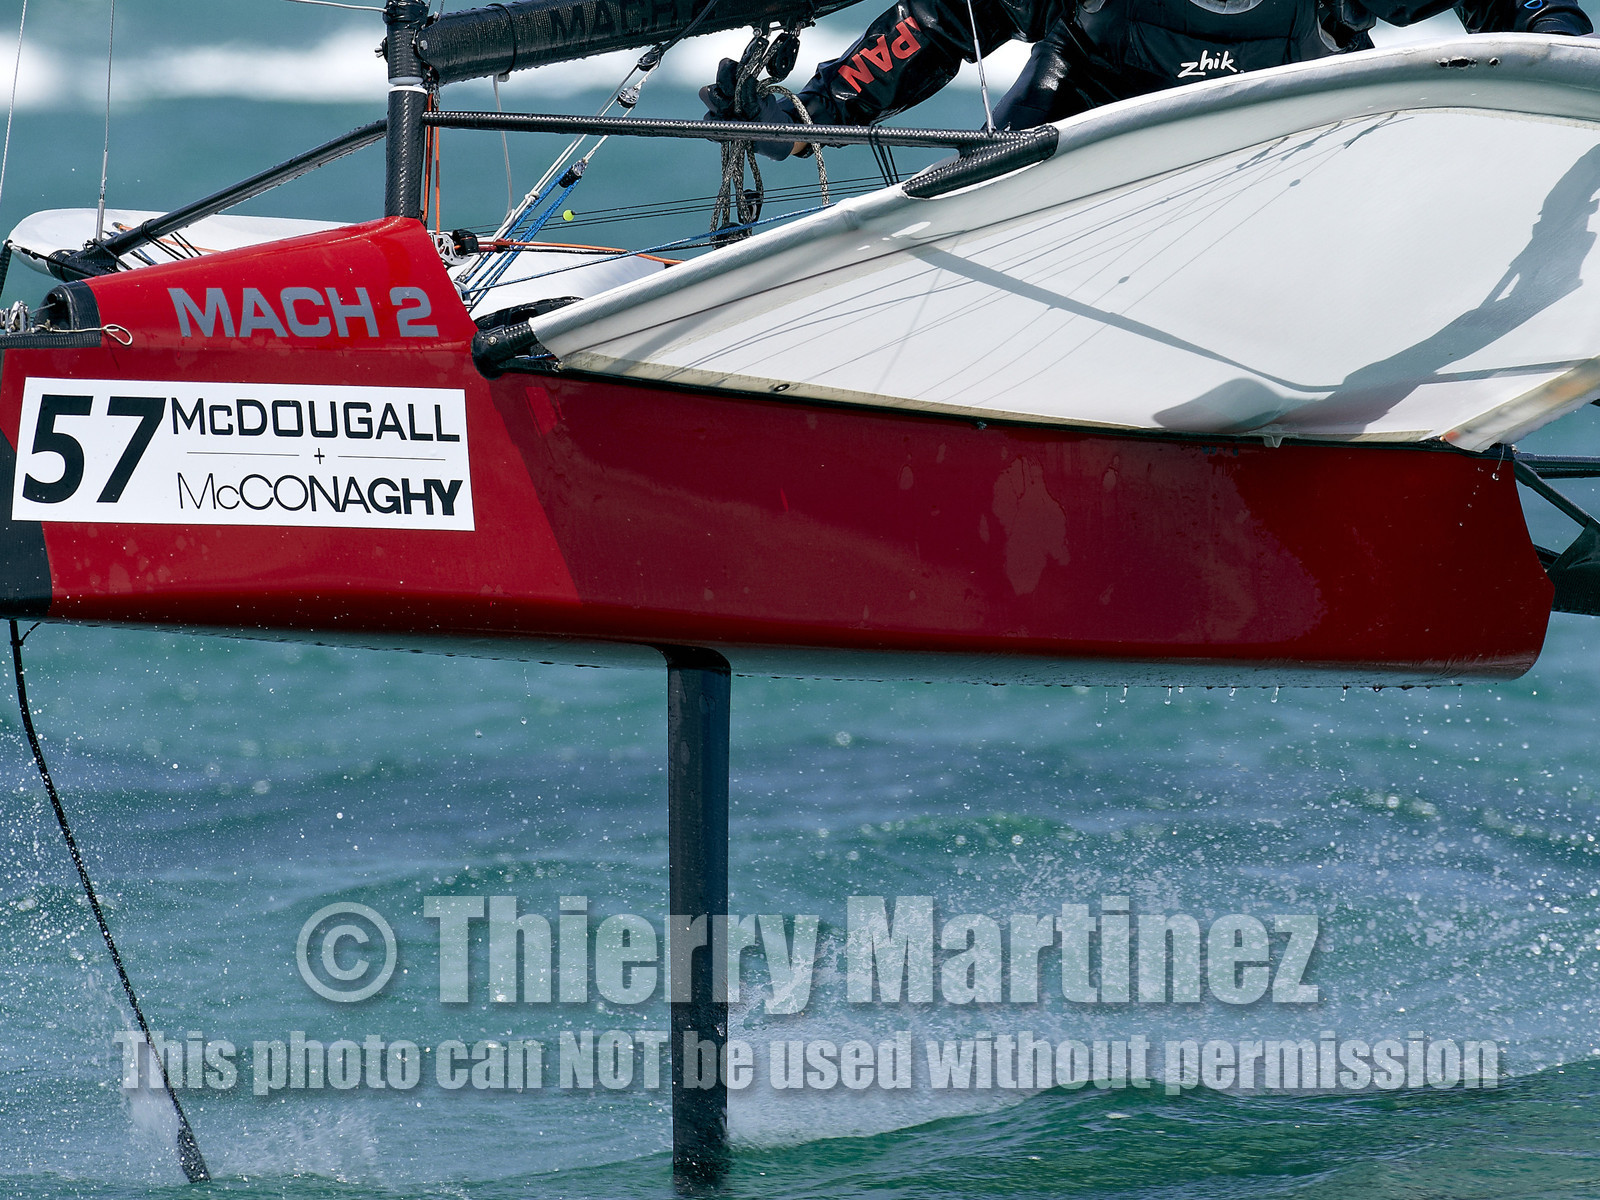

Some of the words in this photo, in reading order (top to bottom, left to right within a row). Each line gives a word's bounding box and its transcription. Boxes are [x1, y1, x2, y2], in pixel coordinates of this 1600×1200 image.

[838, 16, 921, 93] PAN
[1178, 49, 1238, 78] zhik
[167, 287, 380, 337] MACH
[389, 286, 439, 337] 2
[171, 397, 460, 442] McDOUGALL
[22, 394, 167, 504] 57
[177, 472, 464, 516] McCONAGHY
